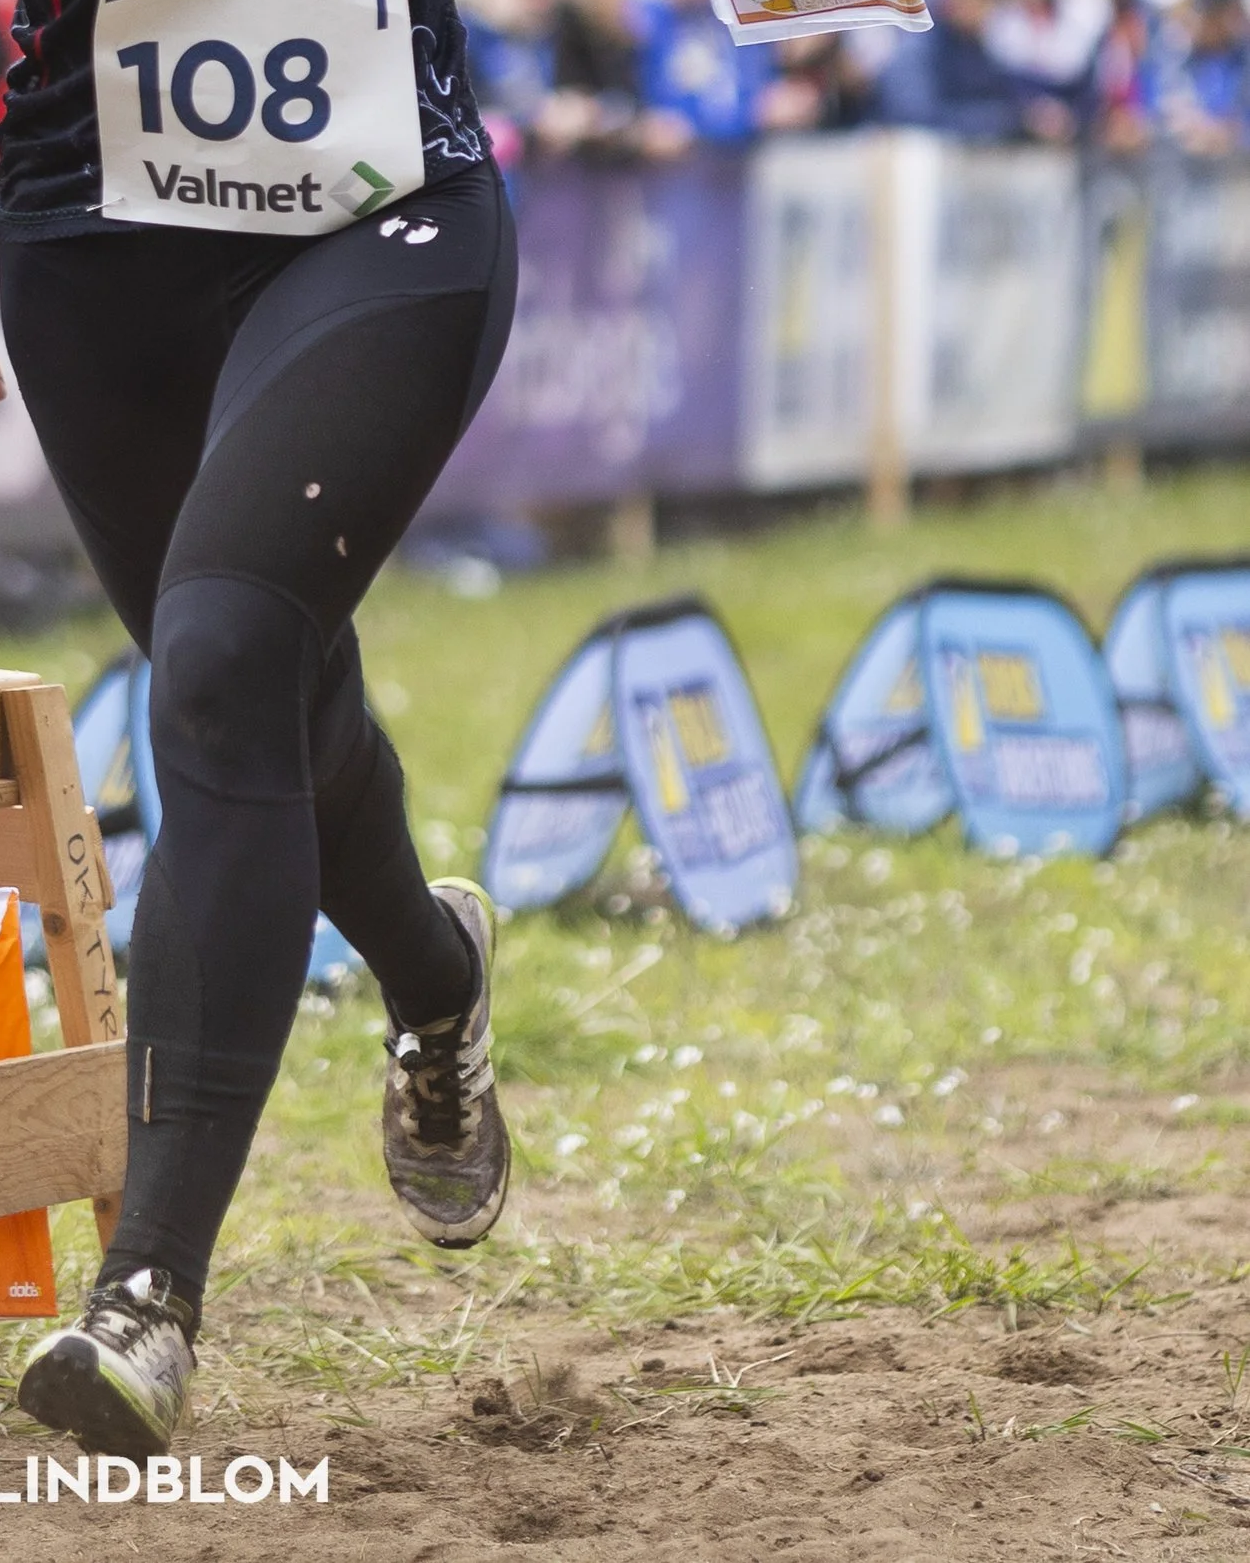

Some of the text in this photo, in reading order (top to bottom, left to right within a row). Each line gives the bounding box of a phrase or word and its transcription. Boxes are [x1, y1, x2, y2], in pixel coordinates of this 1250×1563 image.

[116, 38, 332, 144] 108
[142, 160, 324, 214] Valmet
[67, 833, 94, 914] OK
